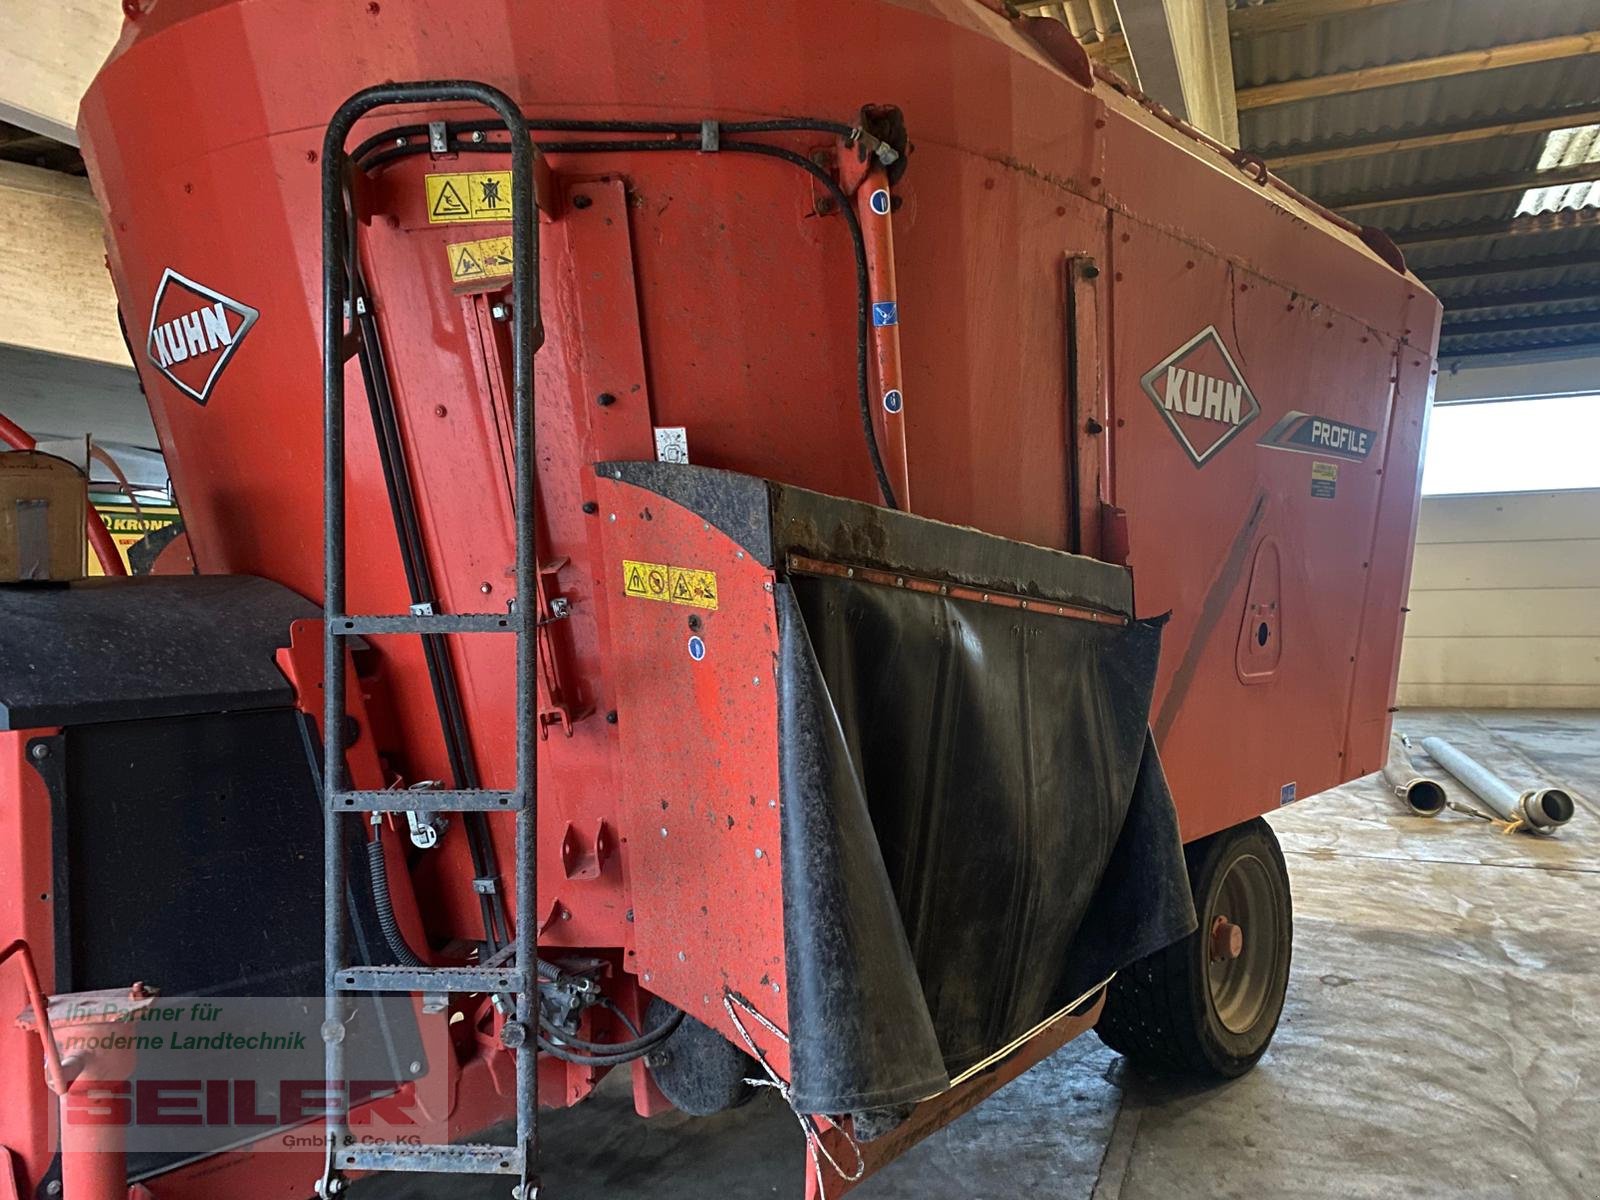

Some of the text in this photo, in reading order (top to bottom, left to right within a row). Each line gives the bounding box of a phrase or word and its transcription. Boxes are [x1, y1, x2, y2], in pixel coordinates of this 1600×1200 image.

[153, 302, 232, 369] KUHN
[1164, 365, 1242, 425] KUHN
[1311, 420, 1368, 454] PROFILE
